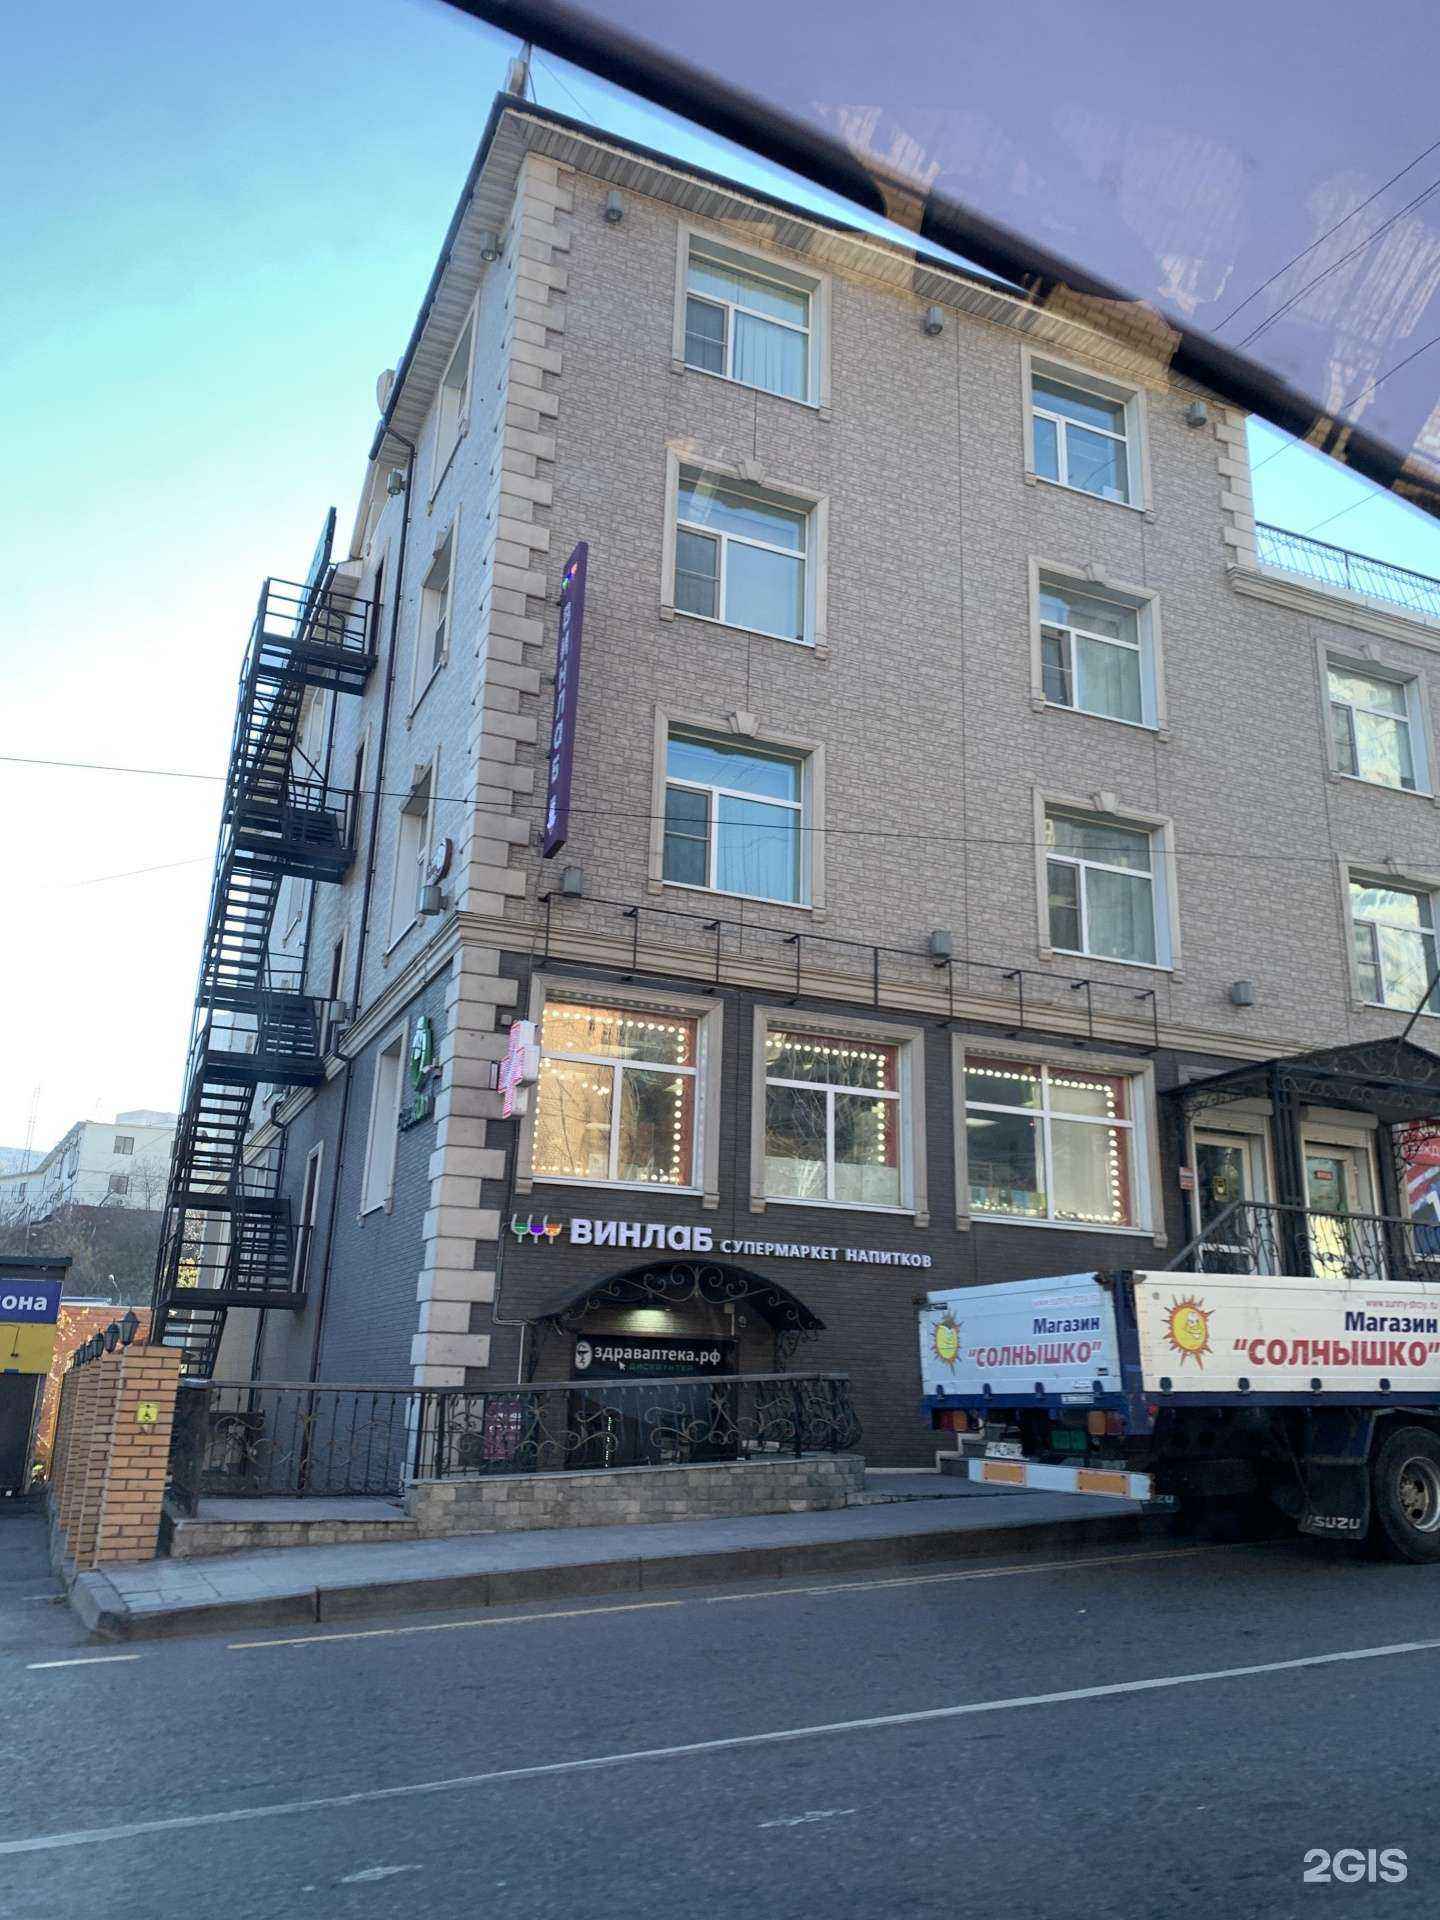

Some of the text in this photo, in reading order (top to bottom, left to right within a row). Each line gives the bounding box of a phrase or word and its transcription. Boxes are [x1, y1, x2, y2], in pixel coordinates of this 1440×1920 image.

[720, 1239, 839, 1261] СУПЕРМАРКЕТ
[845, 1248, 933, 1268] НАПИТКОВ
[0, 1294, 48, 1311] она
[1033, 1317, 1101, 1335] Магазин
[1345, 1311, 1438, 1333] Магазин
[594, 1346, 721, 1366] здраваптека.рф
